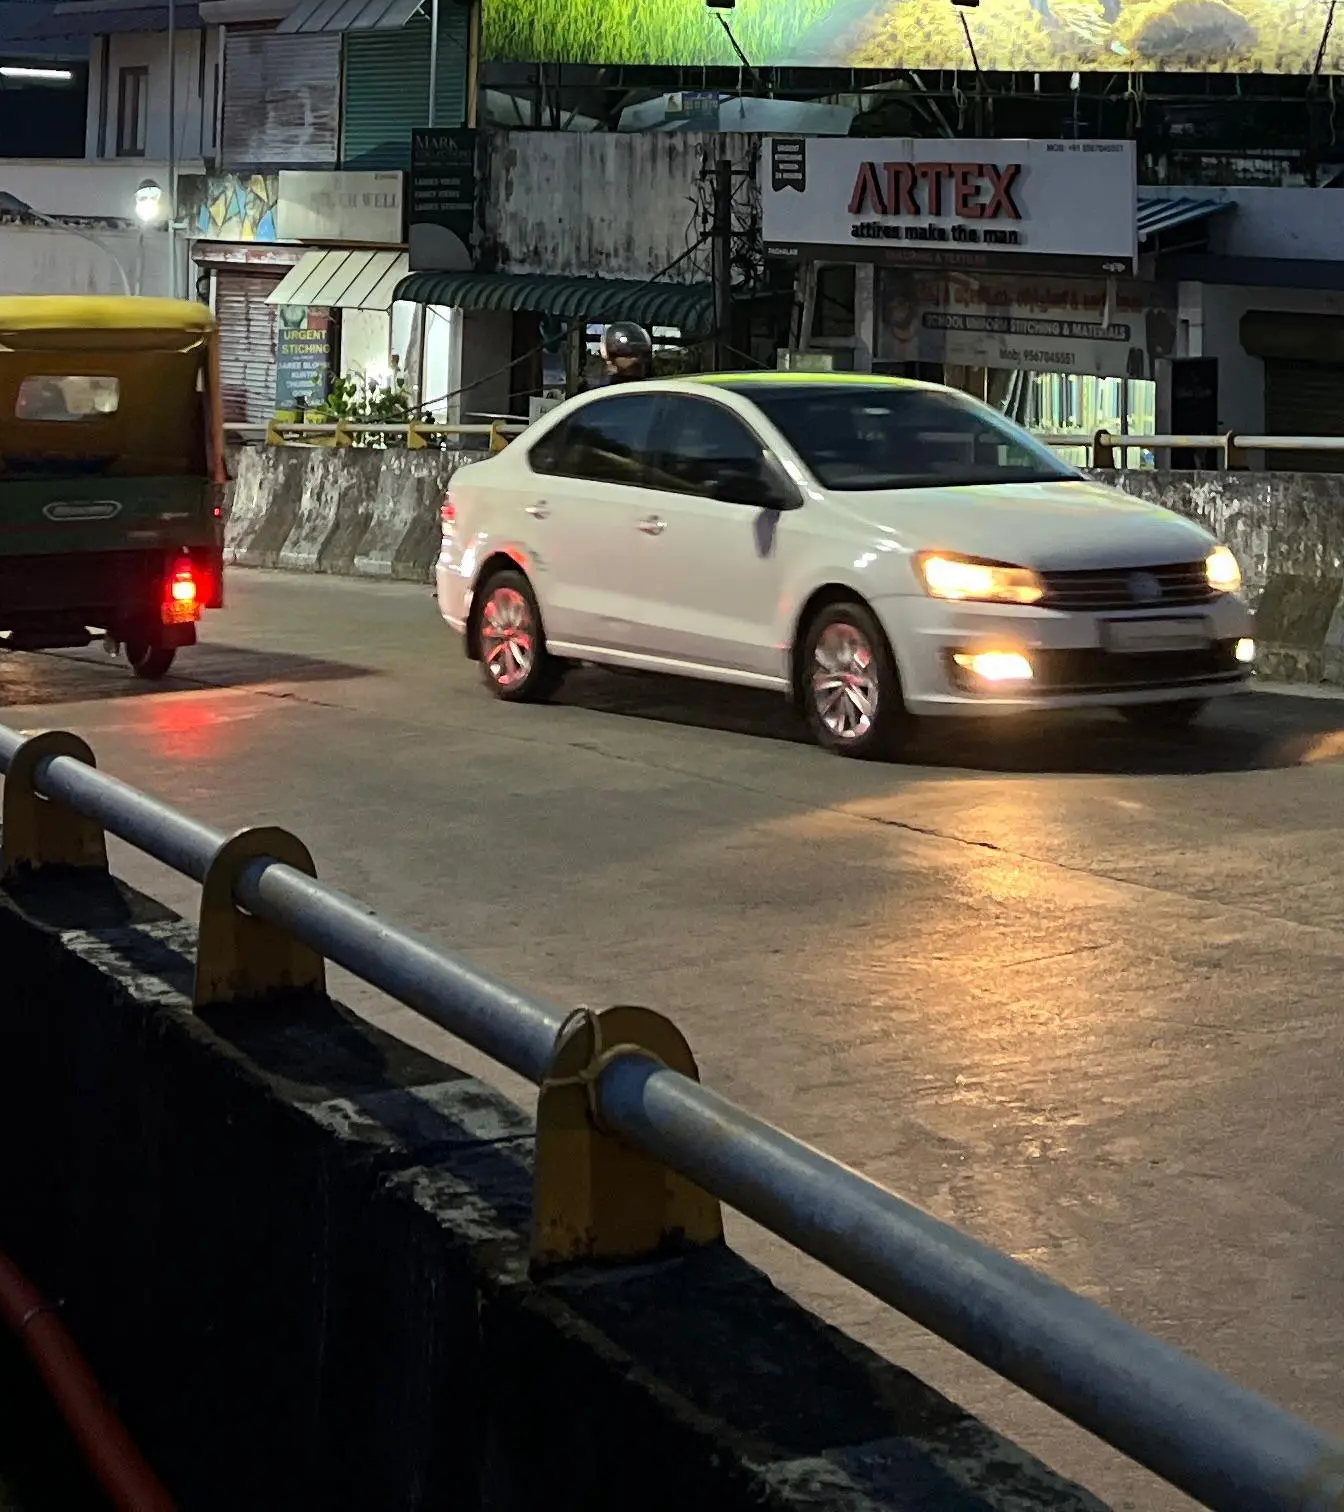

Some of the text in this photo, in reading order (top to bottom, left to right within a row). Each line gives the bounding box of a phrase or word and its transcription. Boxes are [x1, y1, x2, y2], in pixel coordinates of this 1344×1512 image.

[847, 161, 1023, 220] ARTEX
[850, 220, 1020, 245] attires make the man
[283, 330, 327, 340] URGENT
[1061, 322, 1070, 336] &
